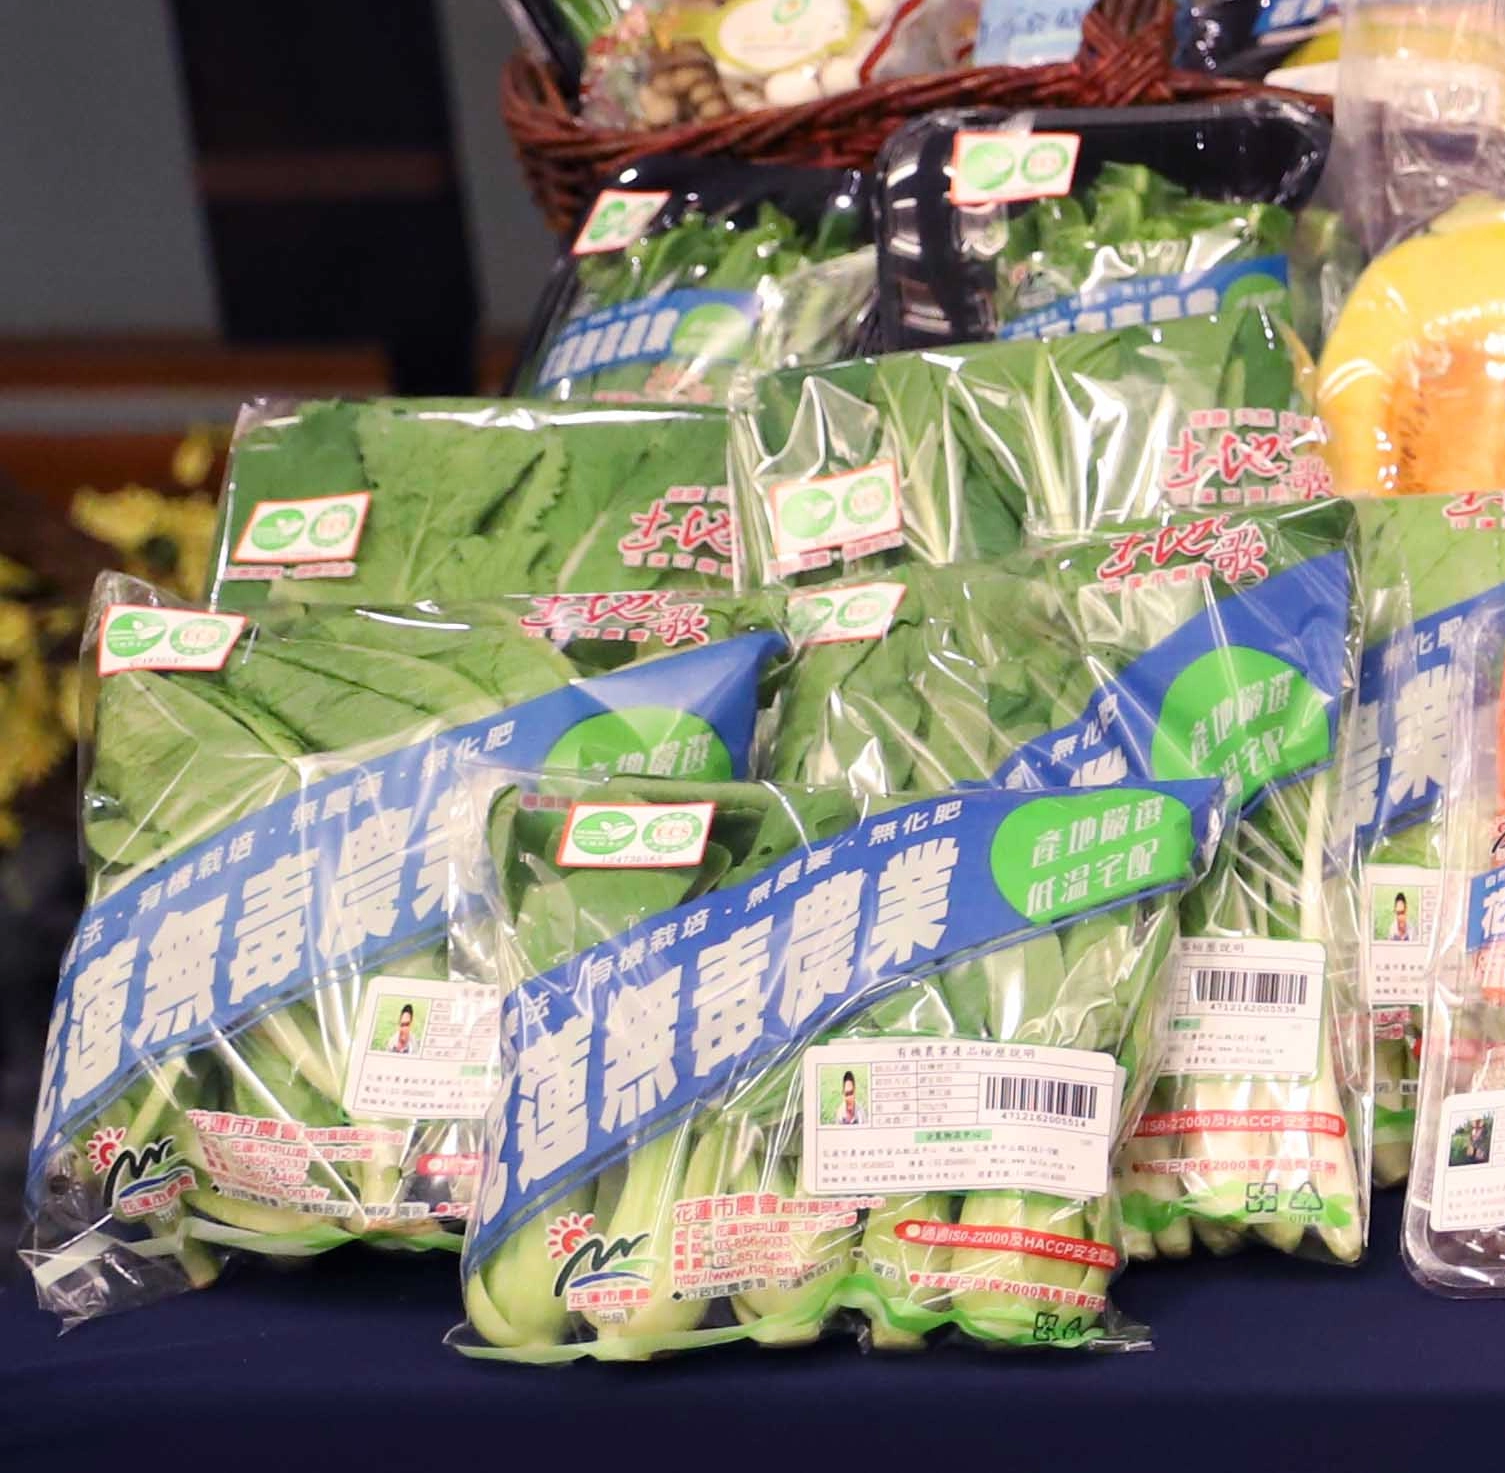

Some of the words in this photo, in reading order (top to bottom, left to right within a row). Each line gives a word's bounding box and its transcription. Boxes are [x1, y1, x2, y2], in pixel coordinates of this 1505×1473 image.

[1031, 796, 1166, 870] 產地嚴選
[136, 829, 256, 915] 有機栽培
[589, 908, 711, 985] 有機栽培
[744, 846, 834, 912] 無農藥
[868, 799, 963, 848] 無化肥
[1026, 838, 1160, 918] 低溫宅配
[1001, 1111, 1087, 1128] 4712162005514
[675, 1193, 779, 1224] 花蓮市農會
